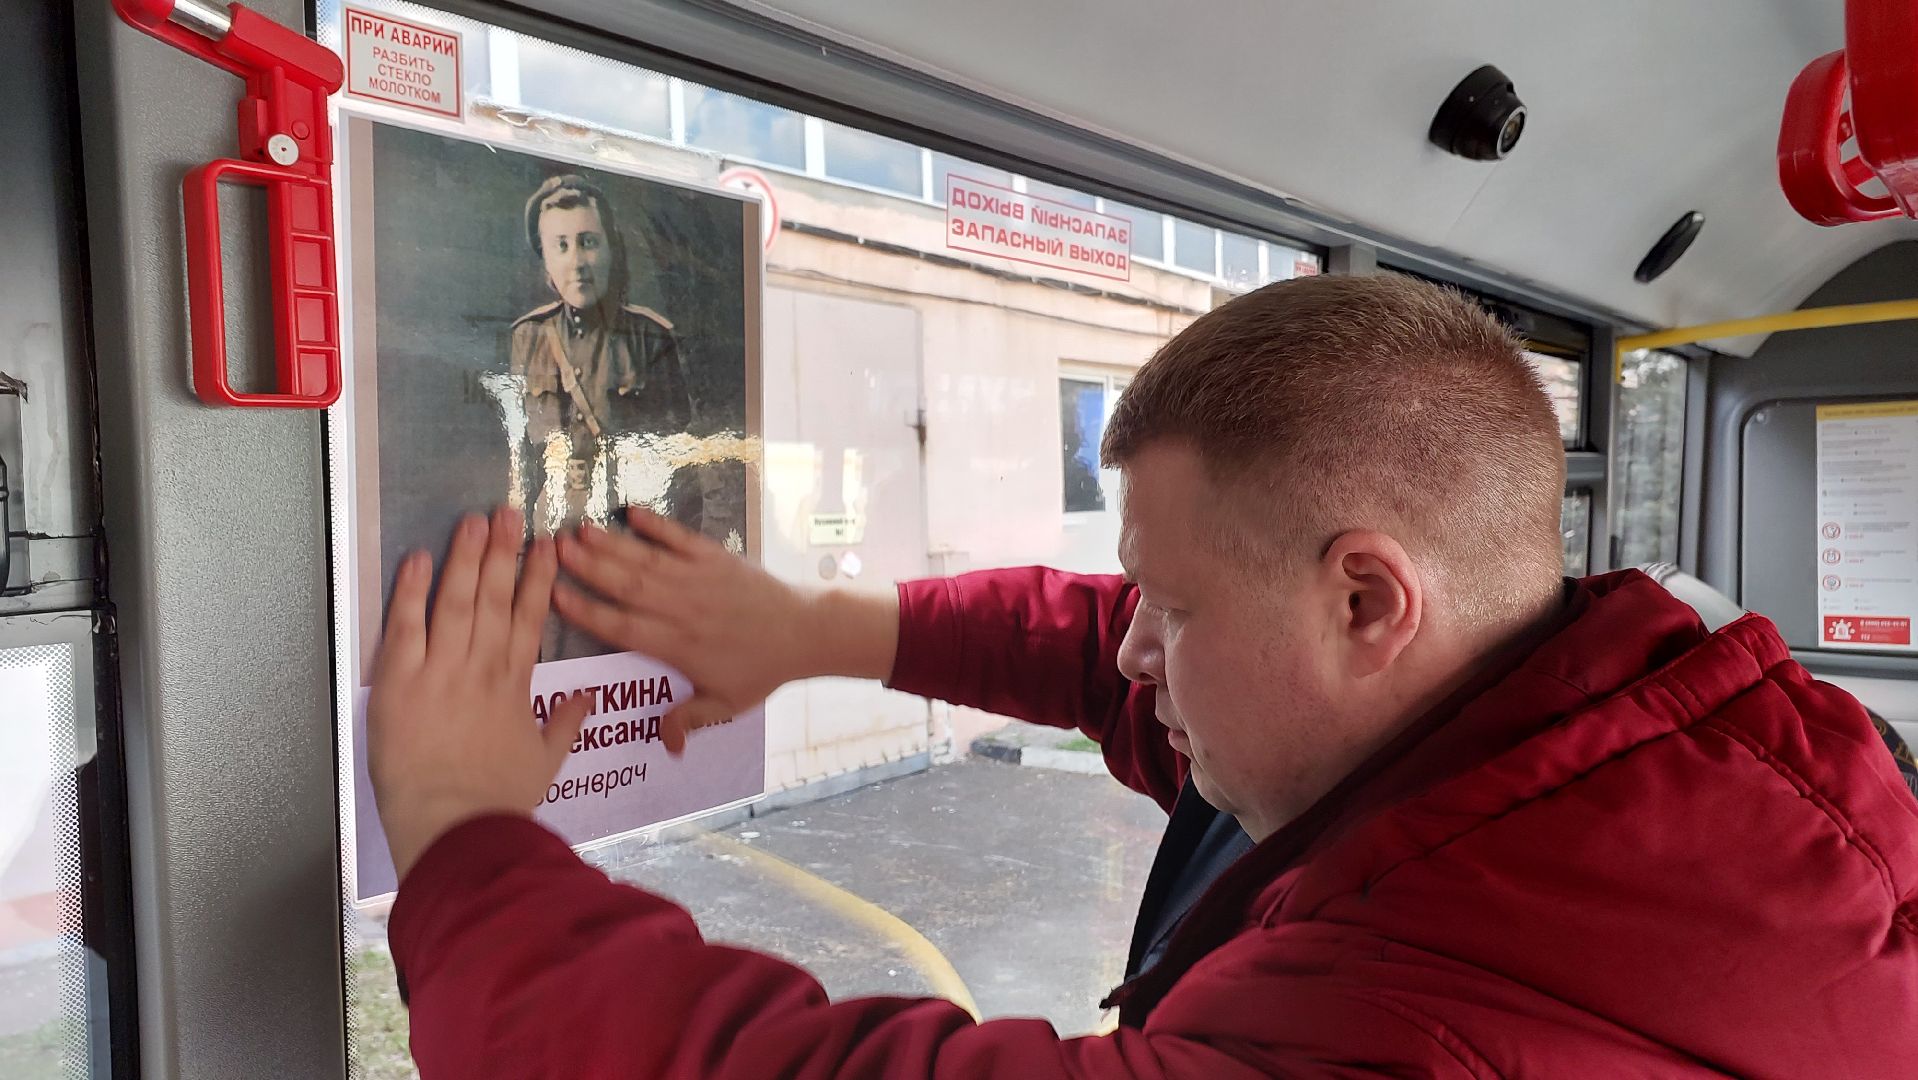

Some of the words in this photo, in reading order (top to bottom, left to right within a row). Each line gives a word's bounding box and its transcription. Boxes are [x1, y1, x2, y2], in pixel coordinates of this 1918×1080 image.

[351, 16, 384, 39] ПРИ
[391, 27, 454, 57] АВАРИИ
[373, 46, 435, 72] РАЗБИТЬ
[378, 63, 431, 86] СТЕКЛО
[369, 76, 441, 103] МОЛОТКОМ
[951, 218, 1064, 257] ЗАПАСНЫЙ
[1069, 244, 1127, 271] ВЫХОД
[536, 762, 647, 806] оенврач
